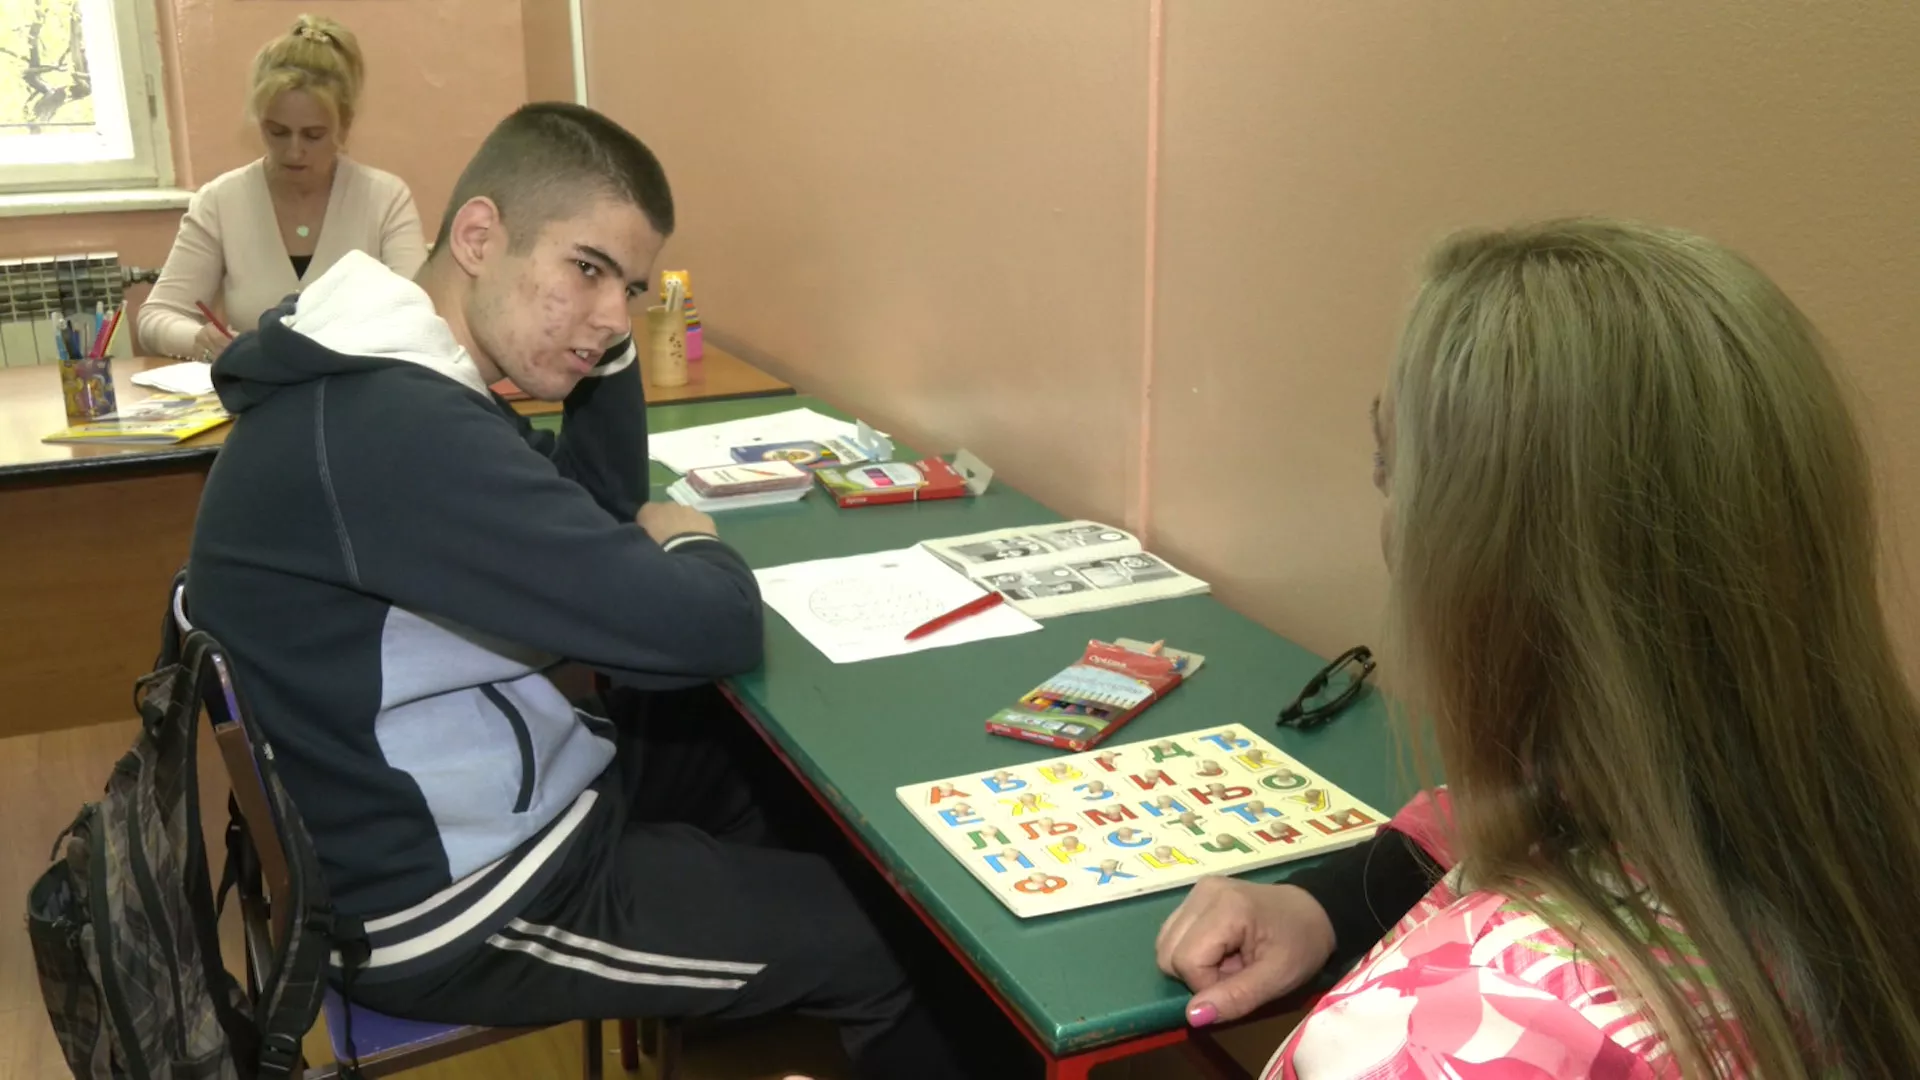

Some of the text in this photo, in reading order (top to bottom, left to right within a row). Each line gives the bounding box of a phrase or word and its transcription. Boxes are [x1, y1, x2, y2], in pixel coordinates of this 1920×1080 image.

[1083, 804, 1139, 826] М
[1262, 773, 1307, 790] О
[1107, 829, 1153, 848] С
